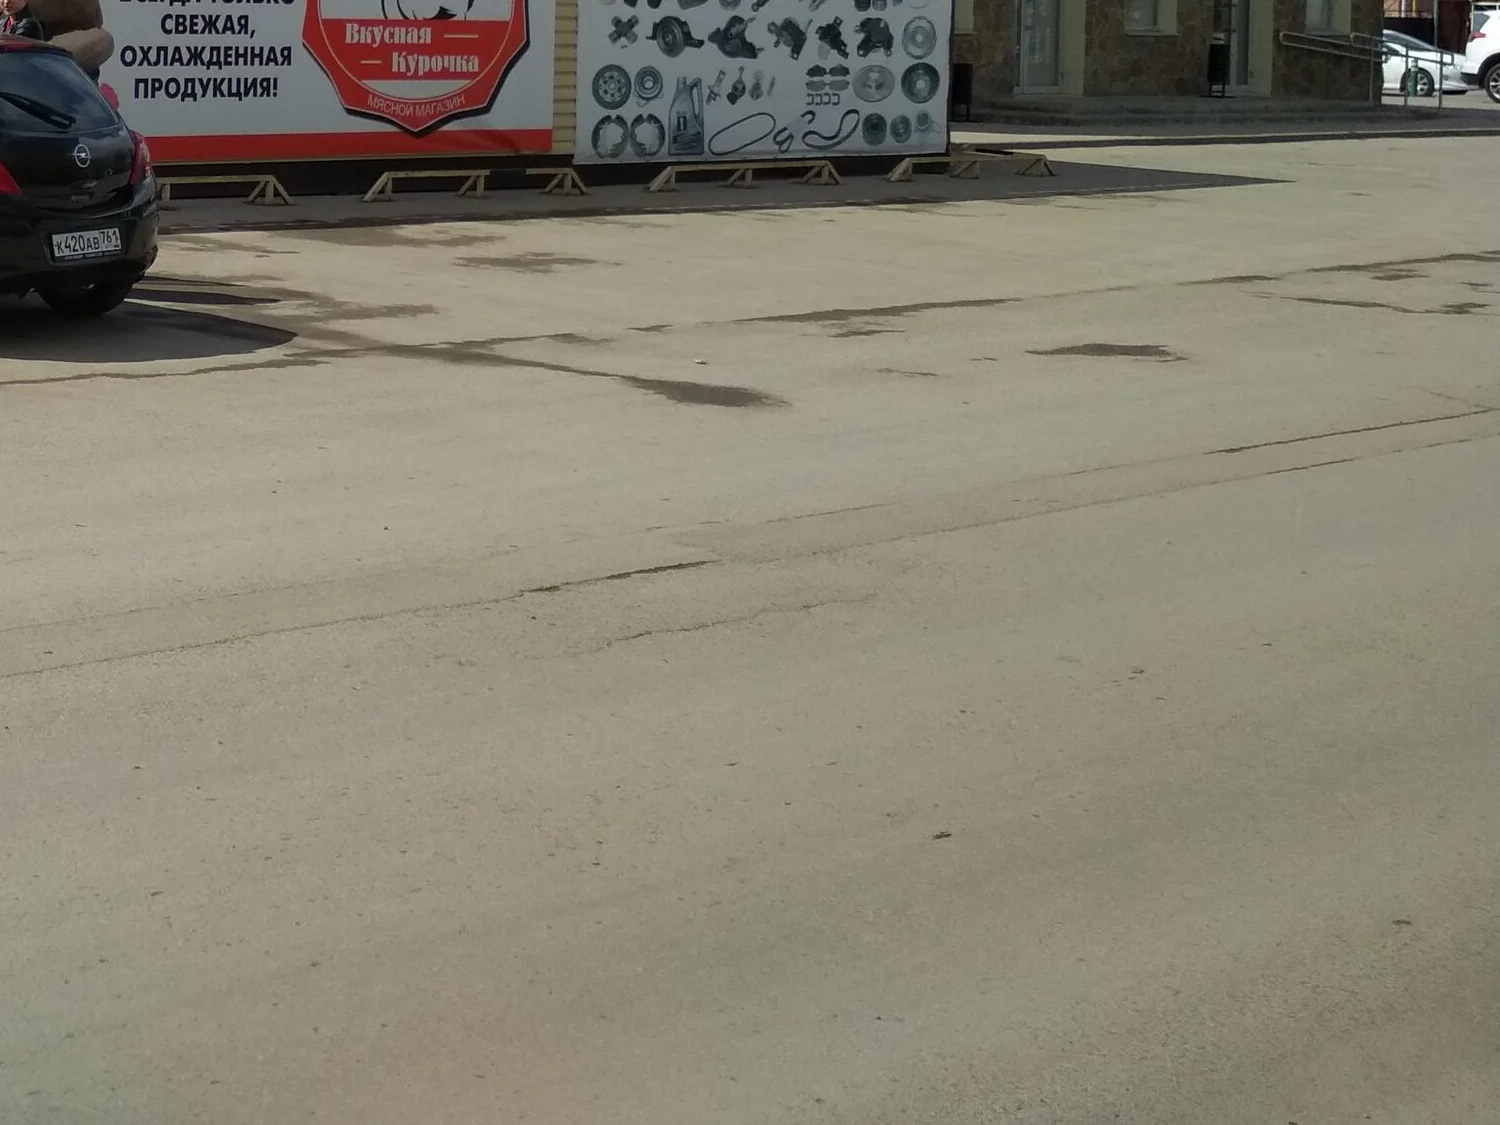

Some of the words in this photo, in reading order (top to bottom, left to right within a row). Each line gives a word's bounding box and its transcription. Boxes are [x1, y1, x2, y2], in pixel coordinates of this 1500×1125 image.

[160, 13, 256, 39] СВЕЖАЯ,
[345, 23, 432, 48] Вкусная
[119, 45, 292, 70] ОХЛАЖДЕННАЯ
[391, 51, 479, 76] Курочка
[134, 77, 278, 102] ПРОДУКЦИЯ!
[367, 94, 415, 117] МЯСНОЙ
[415, 94, 466, 117] МАГАЗИН
